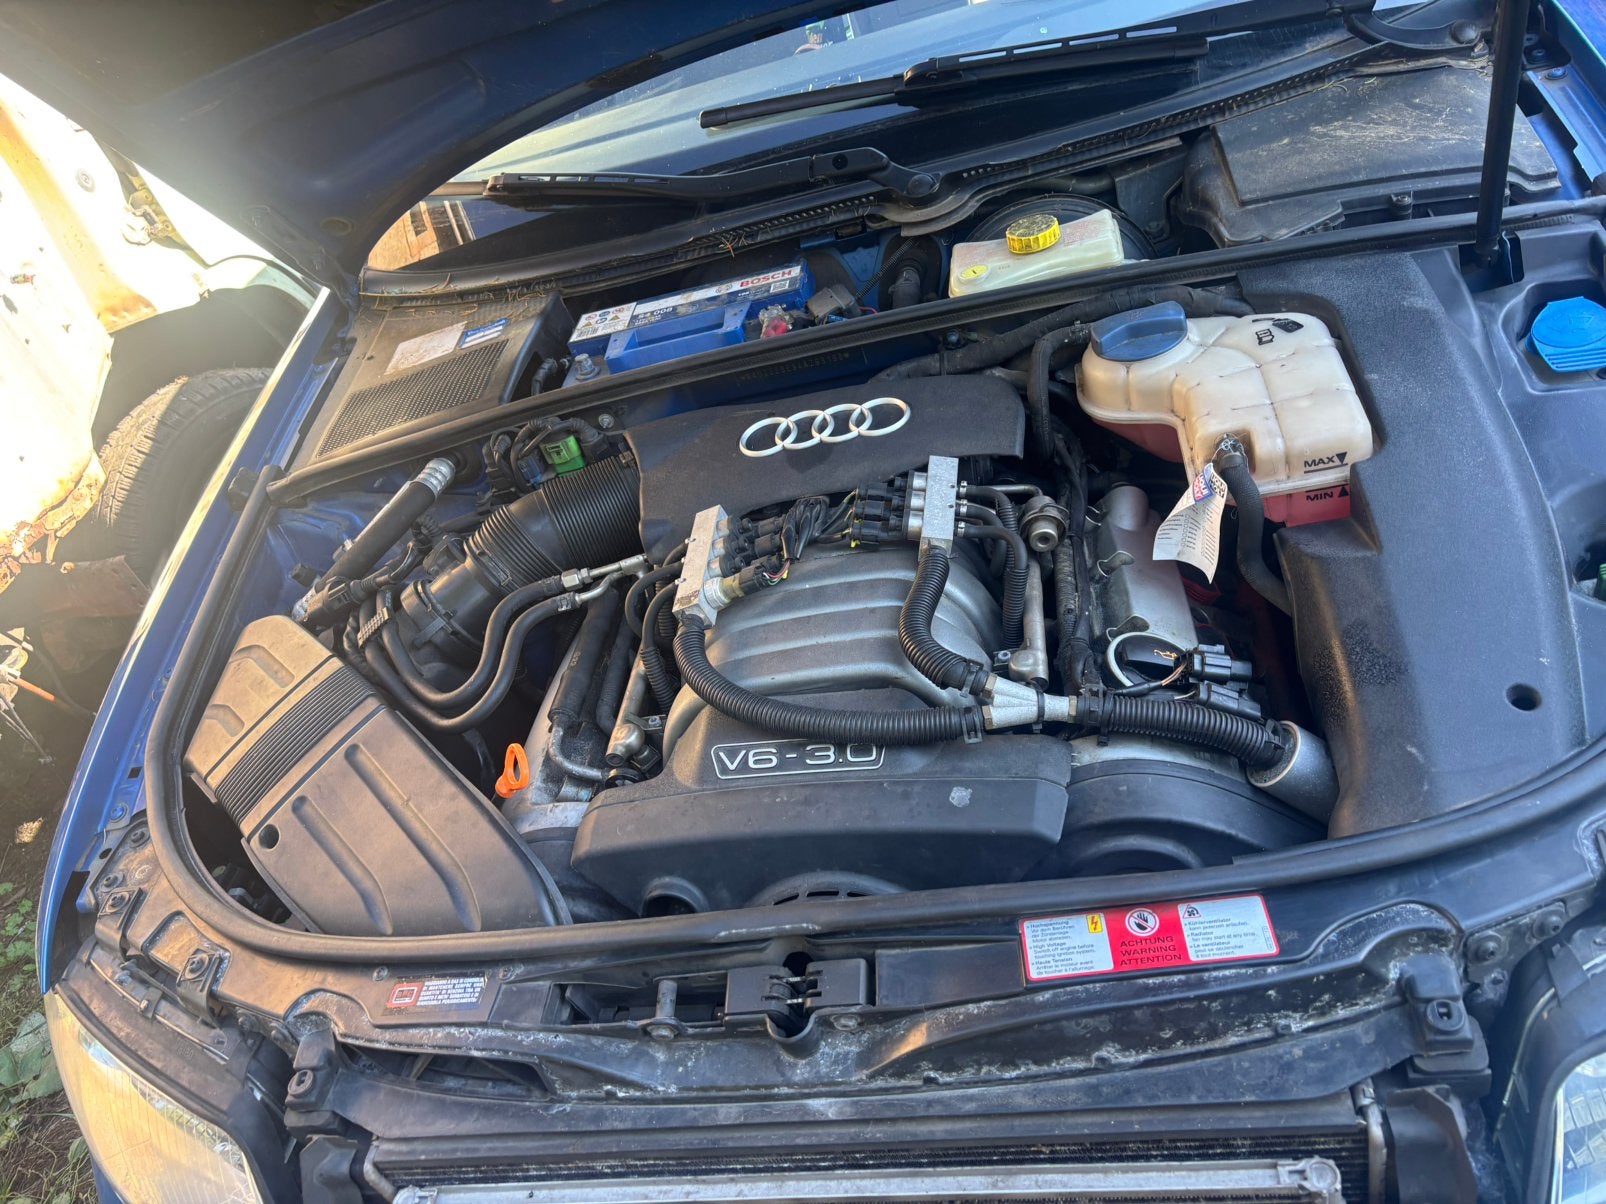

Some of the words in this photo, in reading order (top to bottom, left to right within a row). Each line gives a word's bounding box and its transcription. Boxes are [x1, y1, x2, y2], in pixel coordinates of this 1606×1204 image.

[740, 270, 792, 288] BOSCH
[653, 307, 673, 315] 008
[1304, 456, 1335, 468] MAX
[1306, 491, 1334, 501] MIN
[1121, 936, 1174, 948] ACHTUNG
[1121, 945, 1176, 956] WARNING
[1120, 954, 1182, 966] ATTENTION
